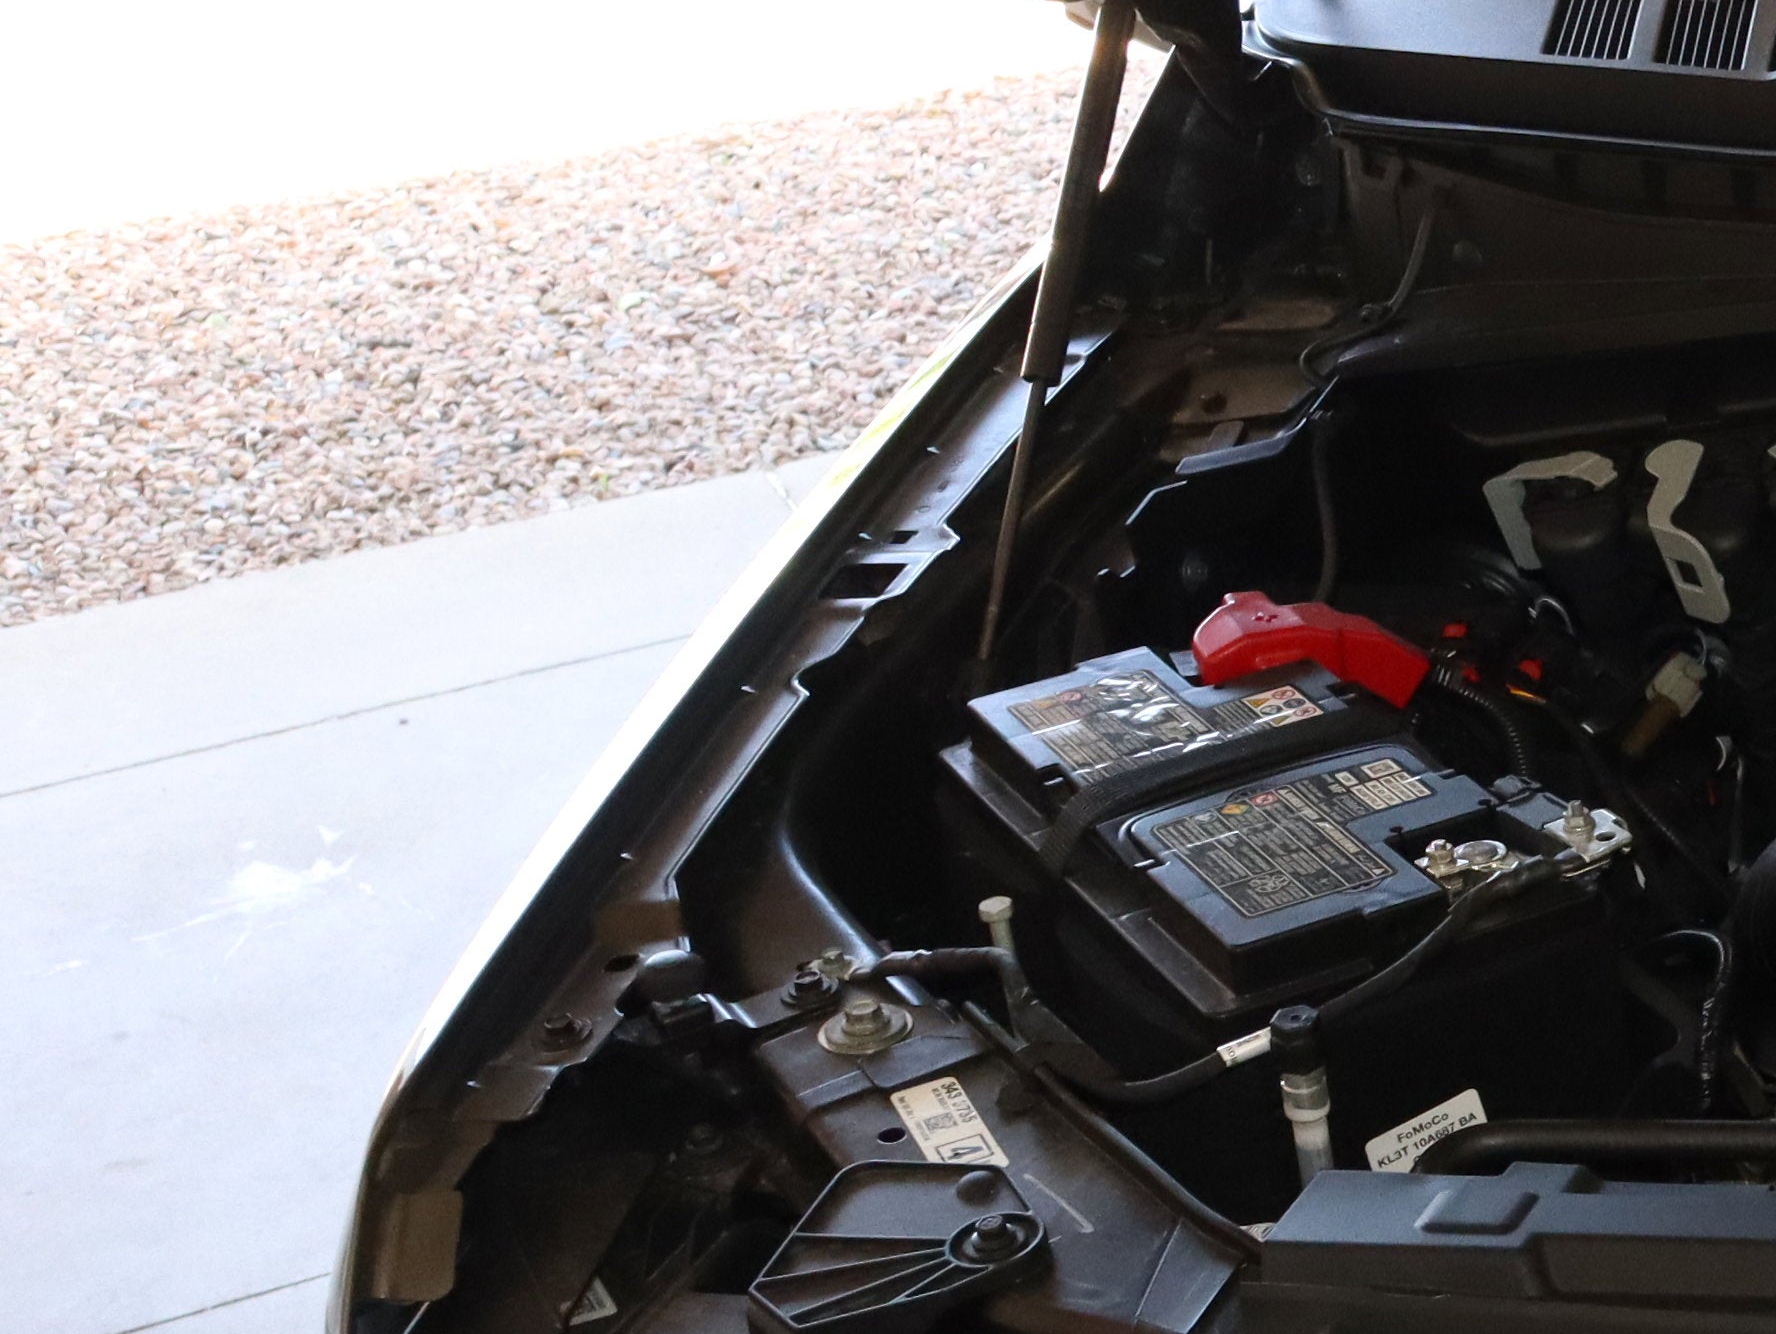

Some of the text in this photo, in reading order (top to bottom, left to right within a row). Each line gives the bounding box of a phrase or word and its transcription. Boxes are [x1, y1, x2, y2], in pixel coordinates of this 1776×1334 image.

[1377, 1112, 1478, 1169] KL3T 10A687 BA
[1396, 1112, 1450, 1143] FoMoCo
